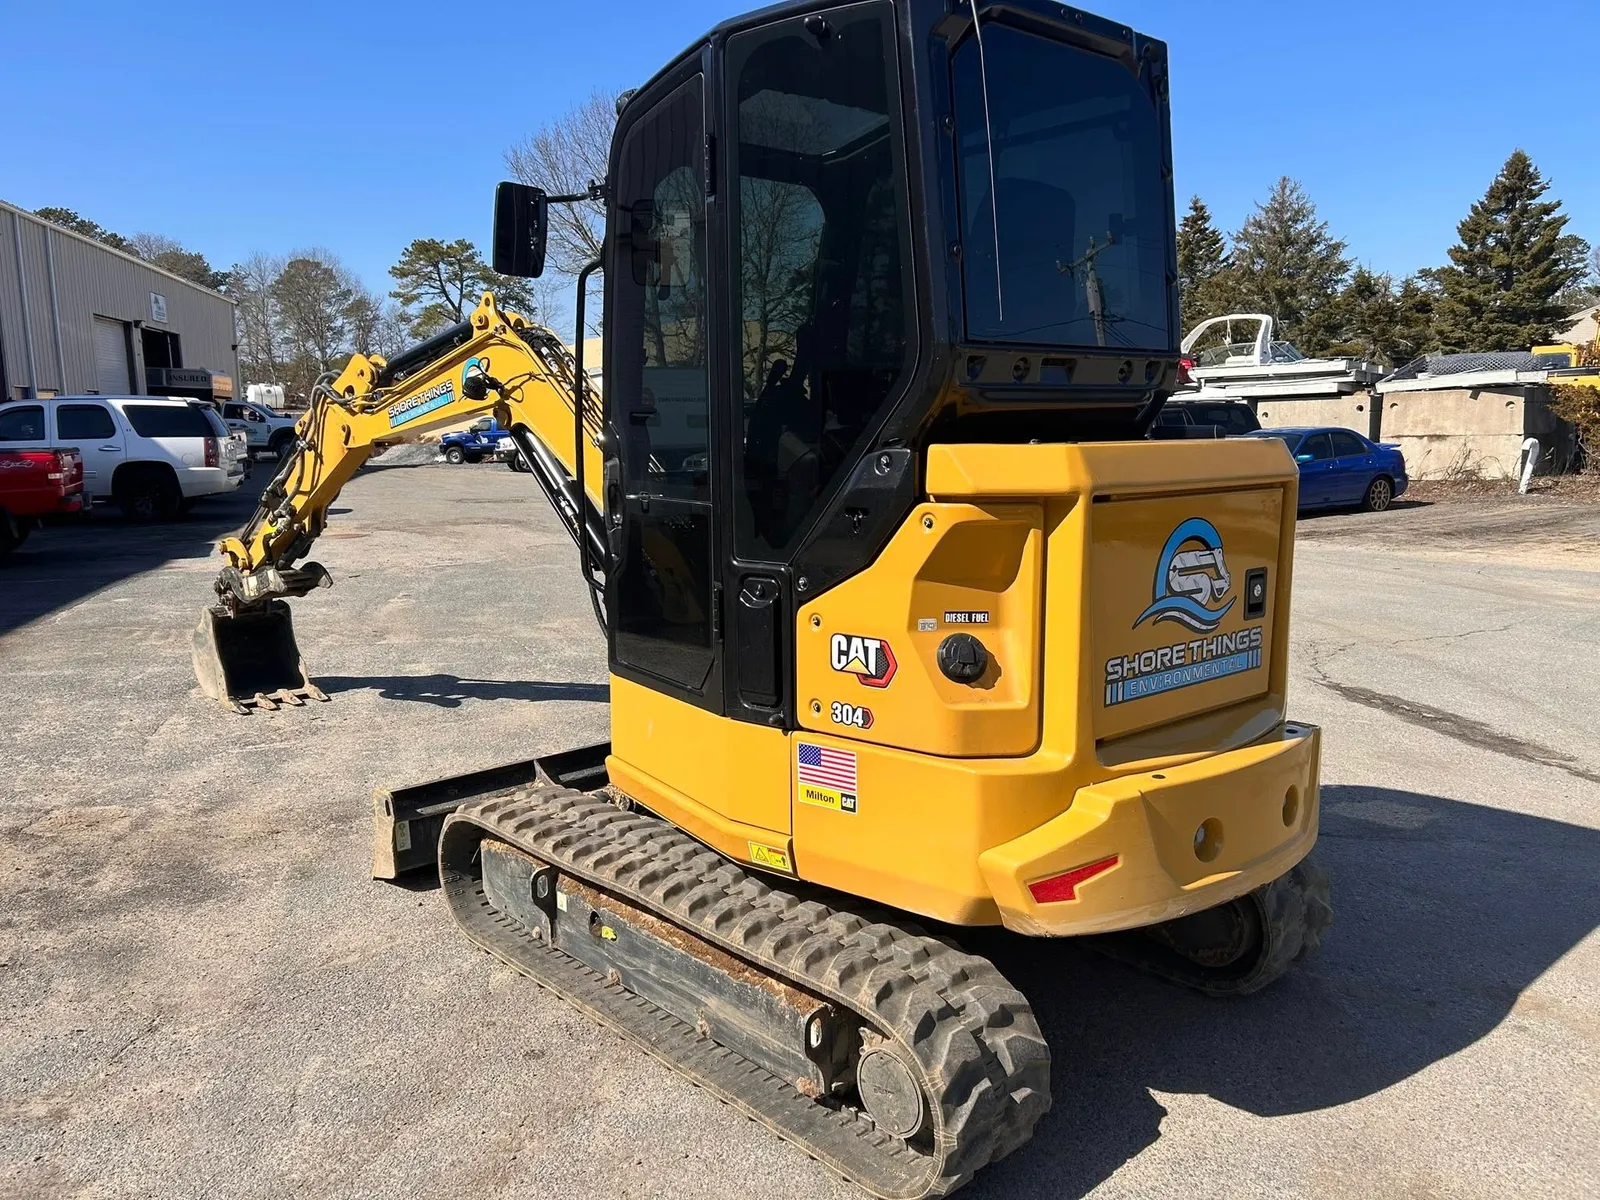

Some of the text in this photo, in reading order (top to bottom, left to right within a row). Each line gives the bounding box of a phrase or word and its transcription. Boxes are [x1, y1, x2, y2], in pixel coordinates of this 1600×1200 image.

[168, 374, 207, 383] INSURED
[388, 397, 419, 418] SHORE
[417, 379, 453, 405] THINGS
[945, 612, 989, 623] DIESEL FUEL
[831, 633, 881, 676] CAT
[1106, 626, 1264, 682] SHORE THINGS
[1129, 656, 1244, 696] ENVIRONMENTAL
[831, 701, 864, 727] 304
[806, 789, 856, 809] Milton CAT
